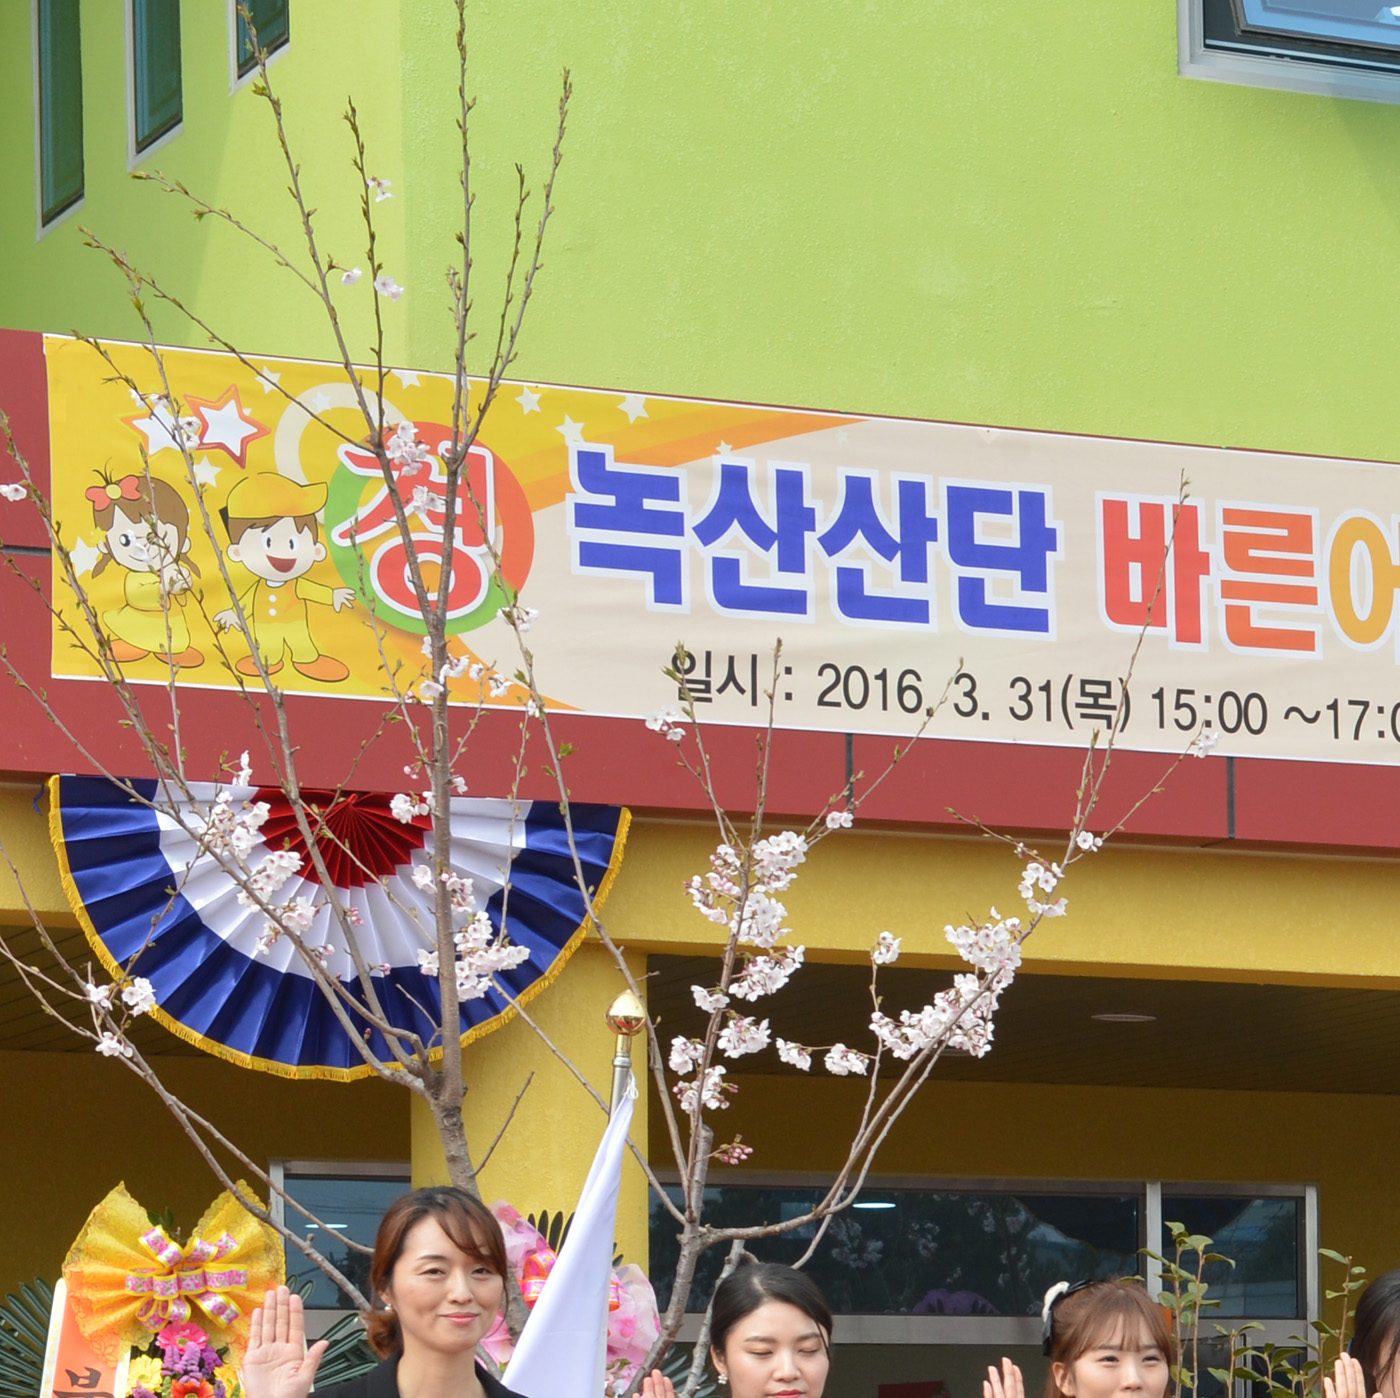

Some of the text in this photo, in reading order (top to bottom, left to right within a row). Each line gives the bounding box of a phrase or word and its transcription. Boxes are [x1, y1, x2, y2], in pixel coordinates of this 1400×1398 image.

[576, 444, 1058, 634] 녹산산단
[673, 651, 759, 707] 일시
[816, 663, 934, 717] 2016.
[953, 674, 991, 722] 3.
[1009, 676, 1129, 734] 31(목)
[1151, 687, 1268, 735] 15:00
